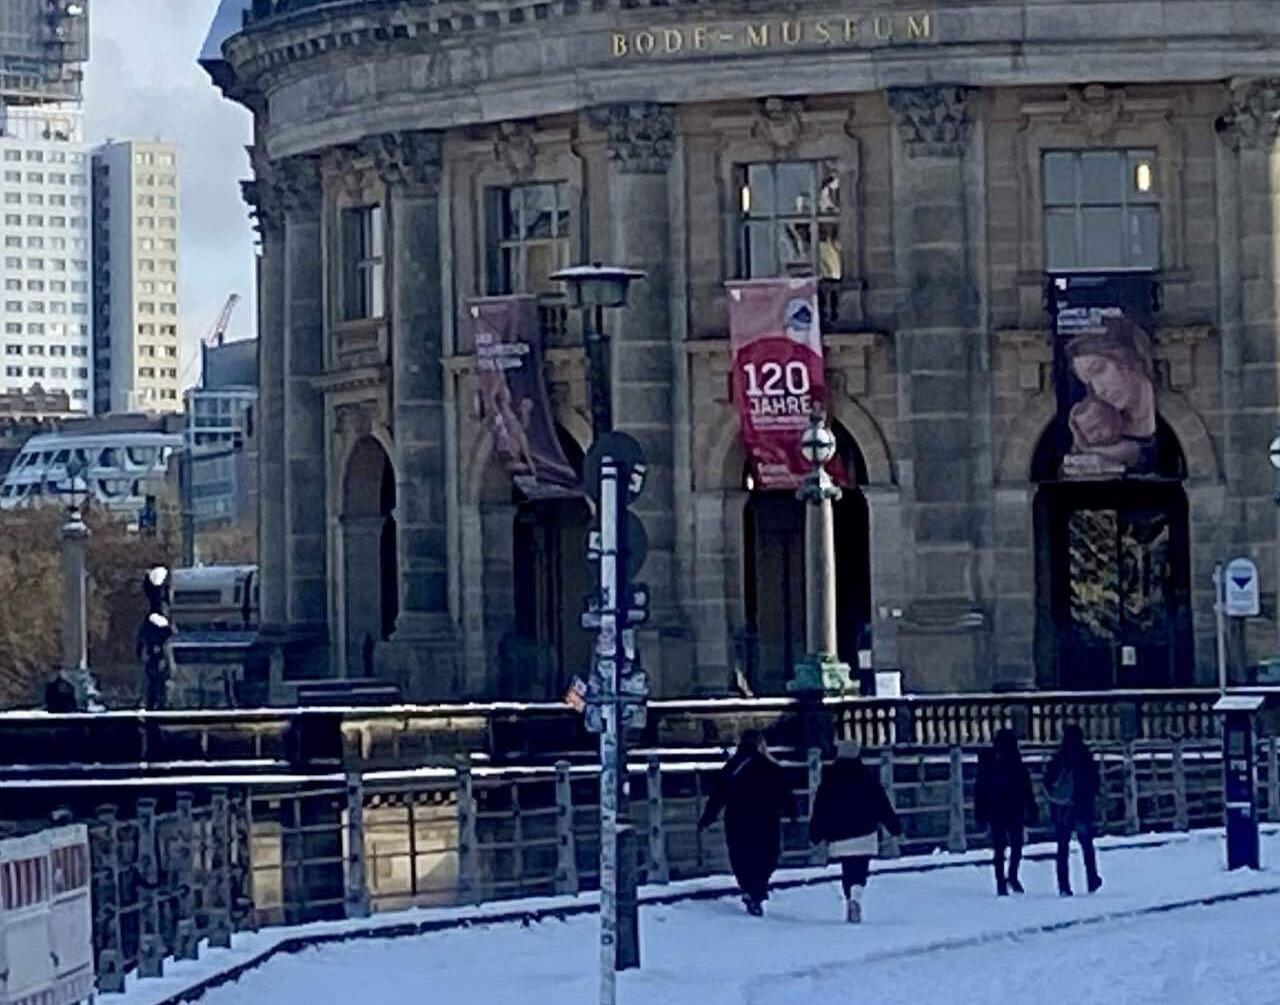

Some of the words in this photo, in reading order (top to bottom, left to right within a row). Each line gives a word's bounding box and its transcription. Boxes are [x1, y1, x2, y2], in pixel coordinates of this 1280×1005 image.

[612, 13, 931, 57] BODE-MUSEUM
[743, 360, 810, 397] 120
[750, 396, 813, 415] JAHRE
